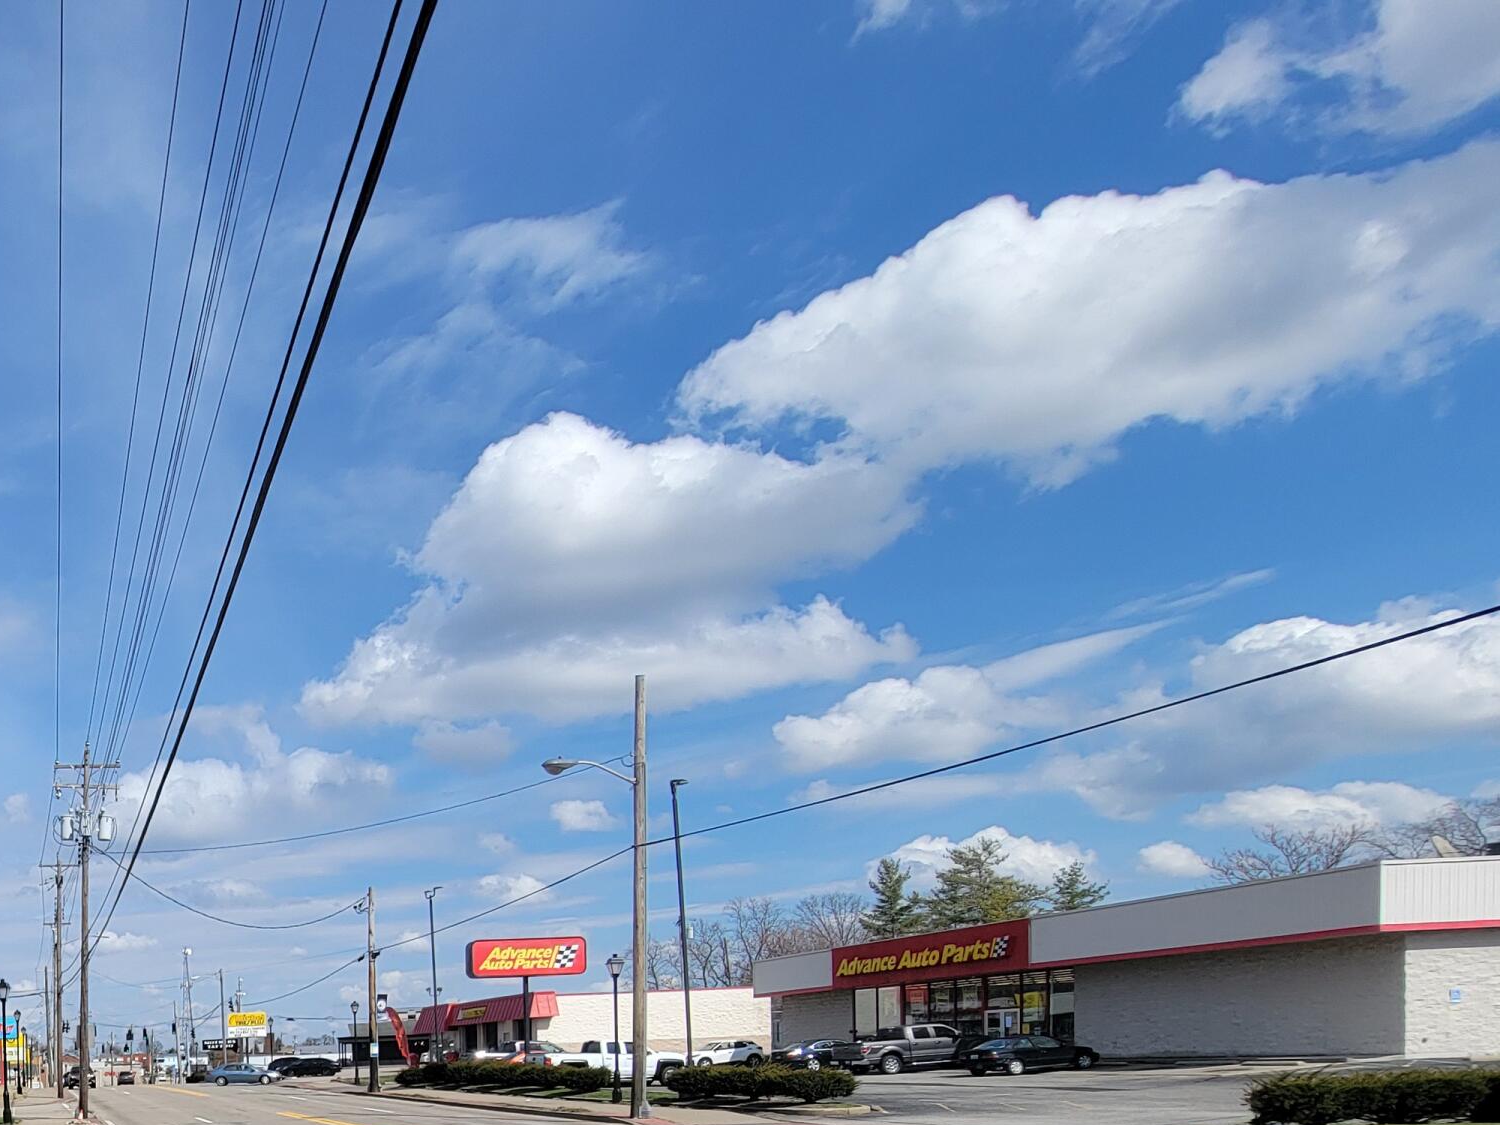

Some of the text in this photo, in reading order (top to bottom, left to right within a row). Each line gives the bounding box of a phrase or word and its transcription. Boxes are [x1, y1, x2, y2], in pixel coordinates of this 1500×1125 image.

[486, 946, 552, 959] Advance
[836, 940, 990, 976] Advance Auto Parts
[479, 958, 550, 970] Auto Parts
